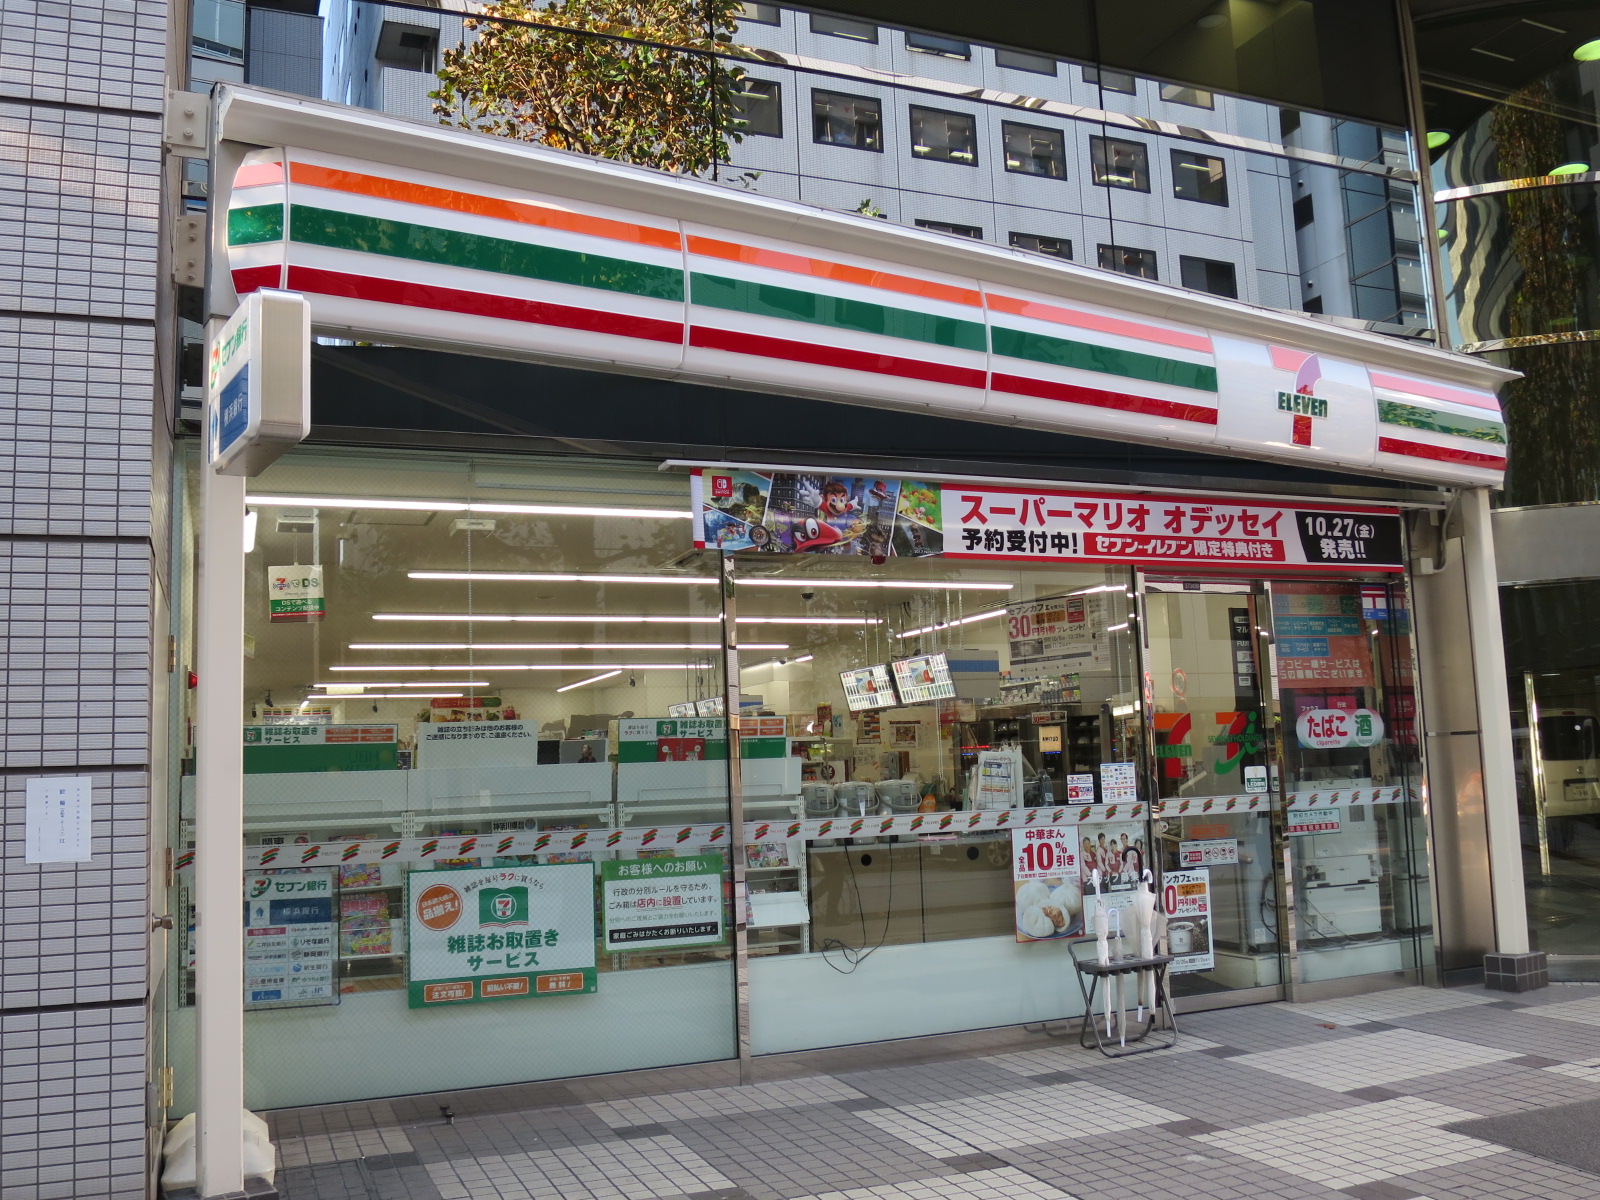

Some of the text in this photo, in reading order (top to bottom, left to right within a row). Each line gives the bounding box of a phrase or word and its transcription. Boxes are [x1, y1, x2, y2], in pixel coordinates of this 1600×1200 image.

[222, 317, 248, 366] セブン銀行
[223, 392, 244, 428] 横浜銀行
[960, 495, 1284, 538] スーパーマリオ オデッセイ
[1305, 516, 1375, 539] 10.27(金)
[961, 528, 1078, 554] 予約受付中!
[1095, 535, 1274, 559] セブン-イレブン限定特典付き
[1320, 538, 1367, 560] 発売!!
[1008, 614, 1031, 640] 30
[1031, 625, 1056, 636] 円引券
[1056, 623, 1086, 633] プレゼント!
[264, 727, 318, 736] 雑誌お取置き
[679, 729, 714, 737] サービス
[1307, 714, 1348, 738] たばこ
[1354, 714, 1373, 737] 酒
[264, 736, 301, 744] サービス
[1025, 829, 1066, 841] 中華まん
[1018, 856, 1026, 872] 全品
[1022, 841, 1068, 871] 10 %
[1056, 855, 1075, 867] 引き
[618, 860, 708, 876] お客様へのお願い
[275, 880, 328, 893] セブン銀行
[463, 872, 545, 893] 雑誌を毎号ラクに買うなら
[612, 882, 712, 897] 行政の分別ルールを守るため、
[608, 895, 718, 909] ごみ箱は店内に設置しています。
[1165, 885, 1177, 915] 0
[1177, 897, 1198, 907] 円引券
[282, 906, 320, 916] 横浜銀行
[423, 900, 459, 920] 品揃え!
[612, 925, 716, 940] 家庭ごみはかたくお断りいたします。
[447, 929, 560, 955] 雑誌お取置き
[303, 950, 330, 958] 静岡銀行
[467, 951, 540, 972] サービス
[431, 989, 467, 1000] 注文可能!
[486, 982, 524, 992] 前払い不要!
